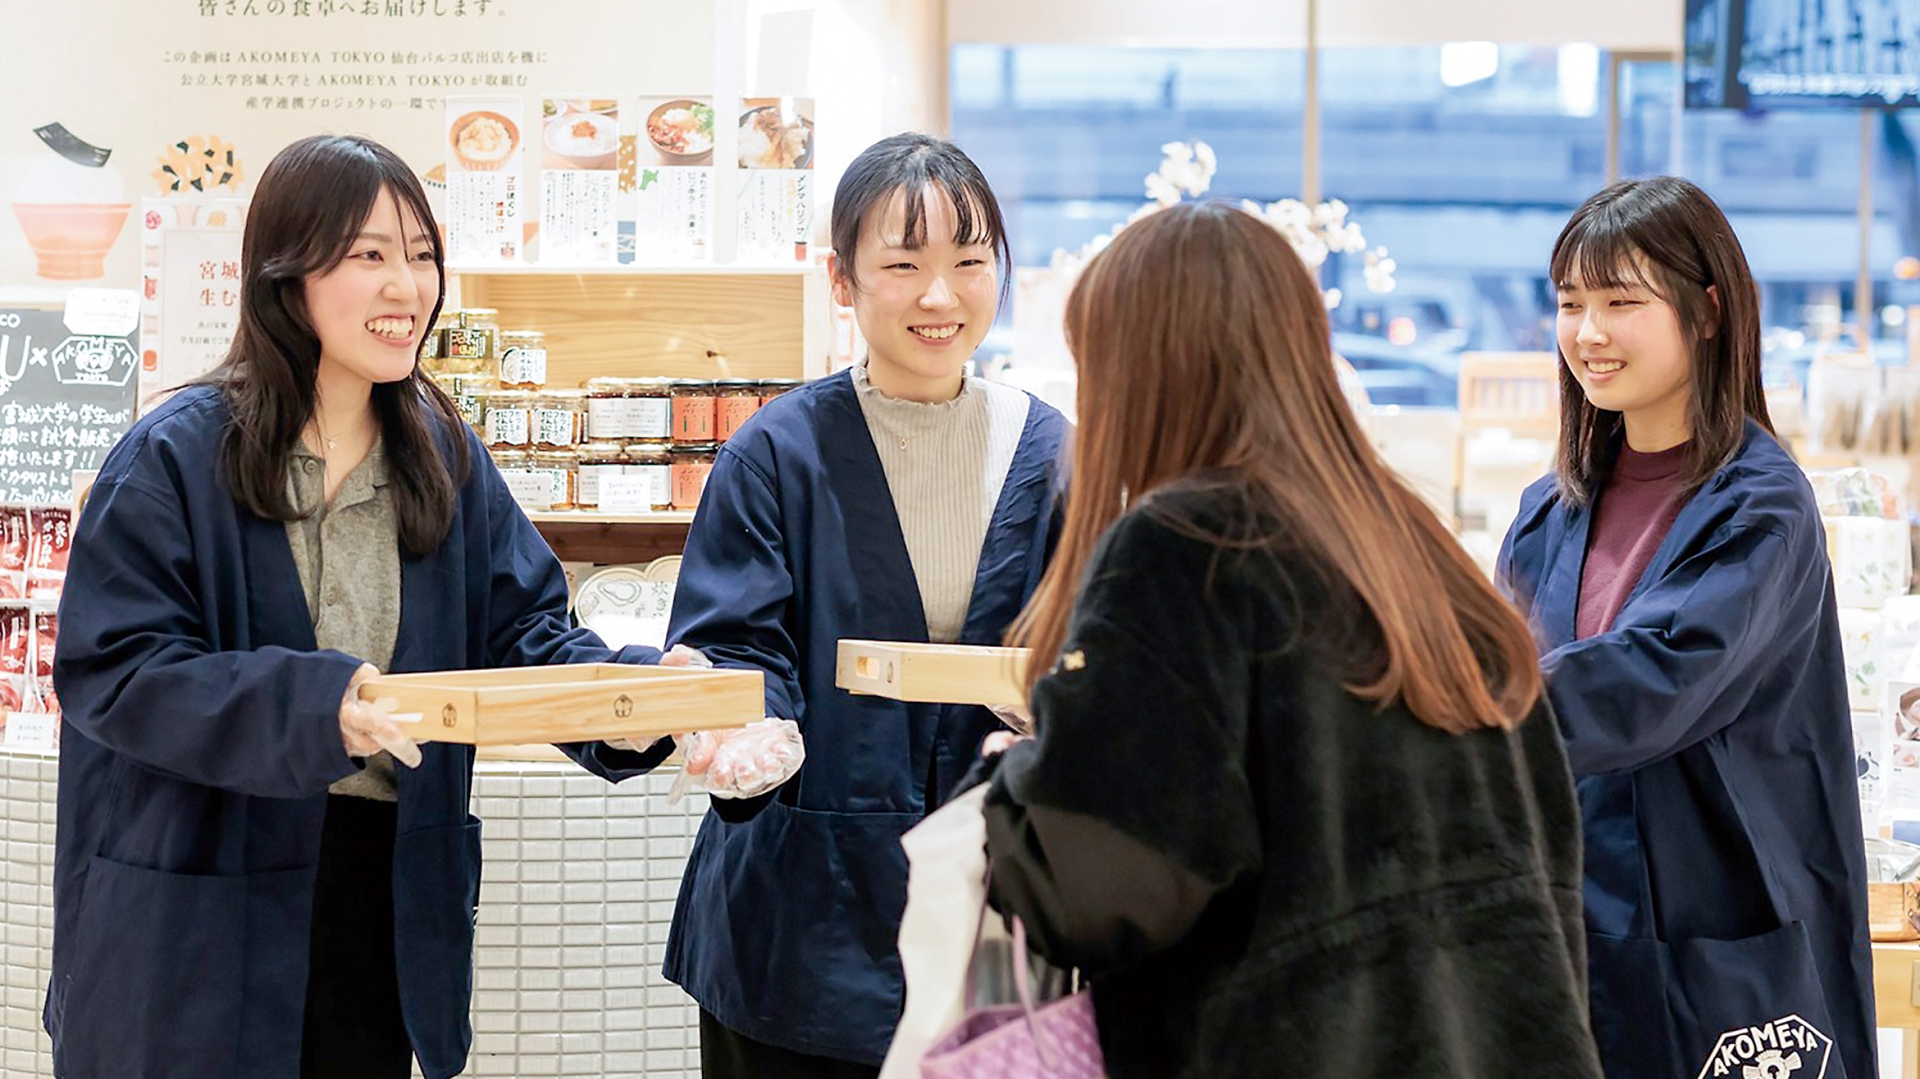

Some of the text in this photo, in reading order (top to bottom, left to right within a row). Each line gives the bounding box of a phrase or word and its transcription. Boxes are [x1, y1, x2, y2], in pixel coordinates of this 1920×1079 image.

[163, 50, 231, 64] この企画は
[237, 51, 321, 63] AKOMEYA
[331, 51, 385, 63] TOKYO
[180, 73, 311, 87] 公立大学宮城大学と
[318, 74, 397, 86] AKOMEYA
[407, 74, 465, 86] TOKYO
[1713, 1022, 1818, 1077] AKOMEYA
